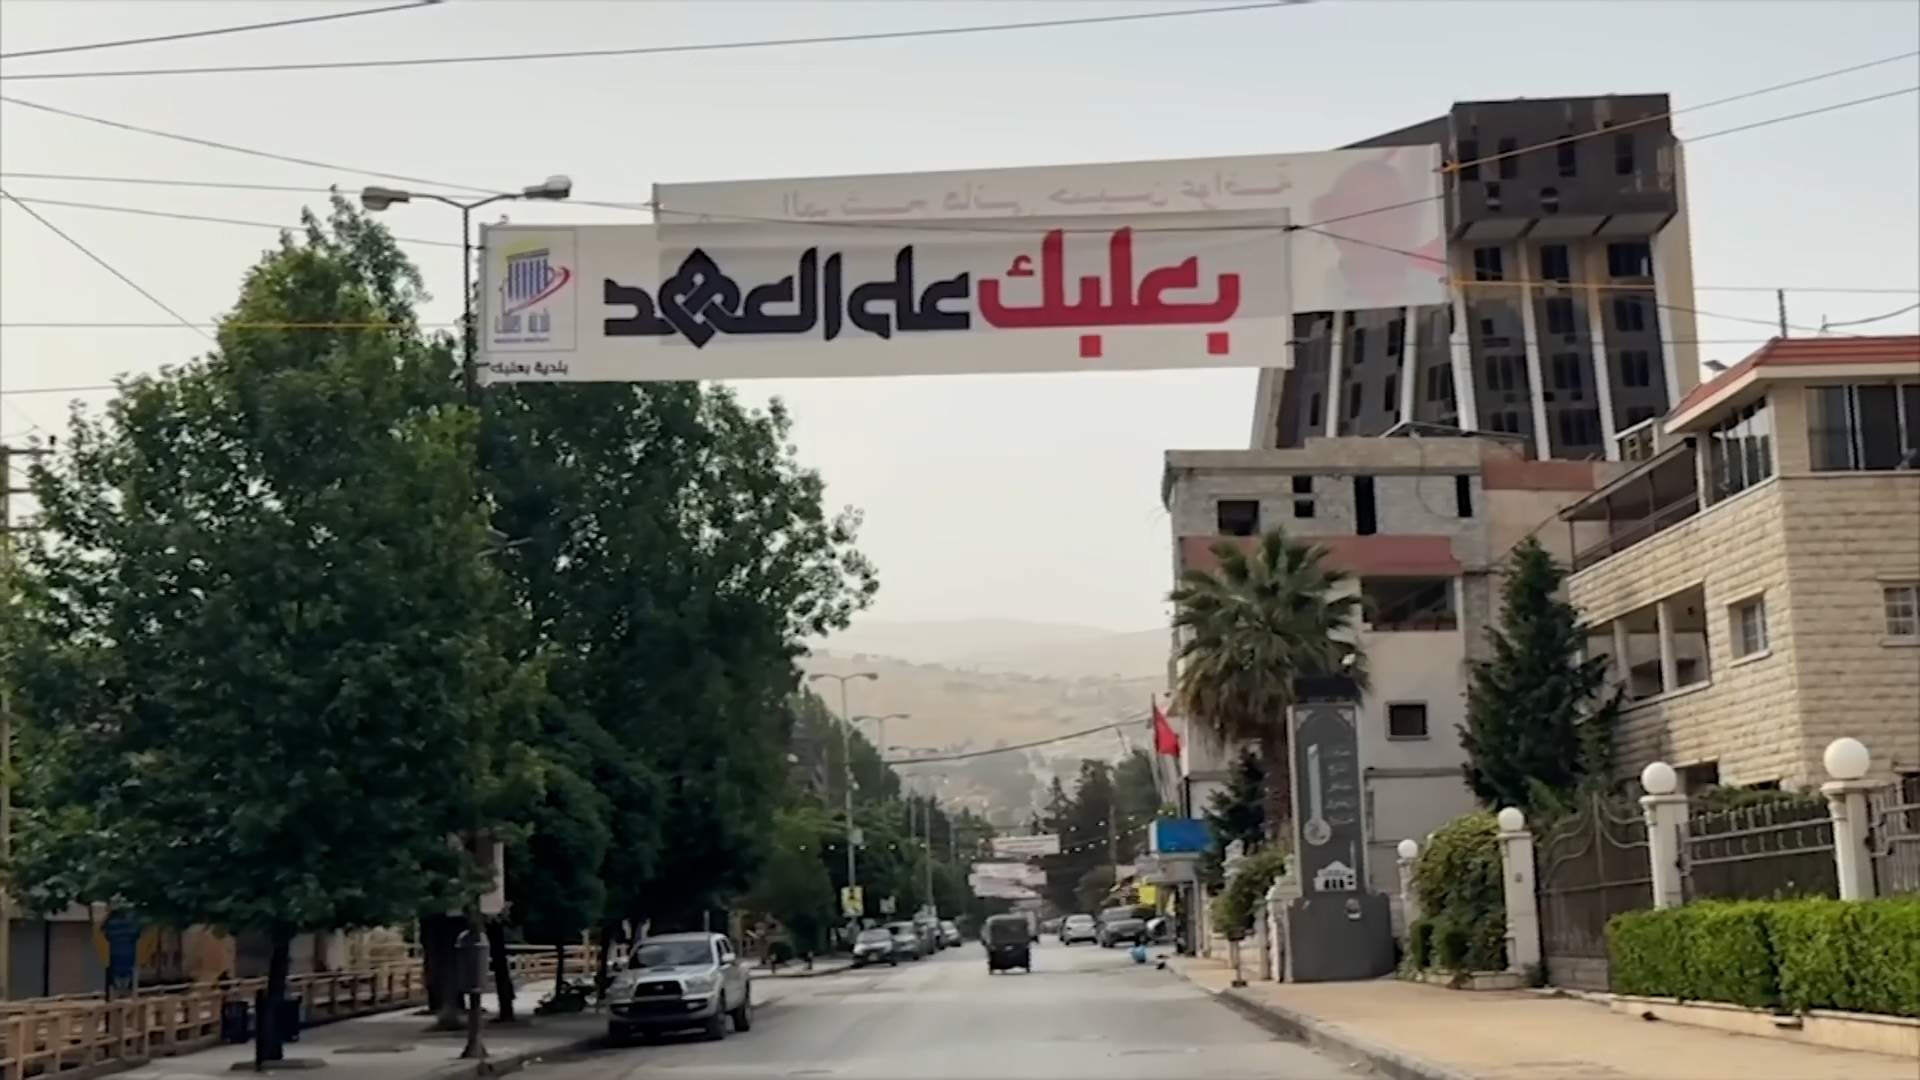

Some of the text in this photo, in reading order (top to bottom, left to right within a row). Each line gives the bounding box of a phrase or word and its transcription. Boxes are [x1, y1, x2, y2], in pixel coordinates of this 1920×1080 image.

[604, 226, 1240, 358] بعلبك على العهد
[490, 360, 569, 376] بلدية بعلبك
